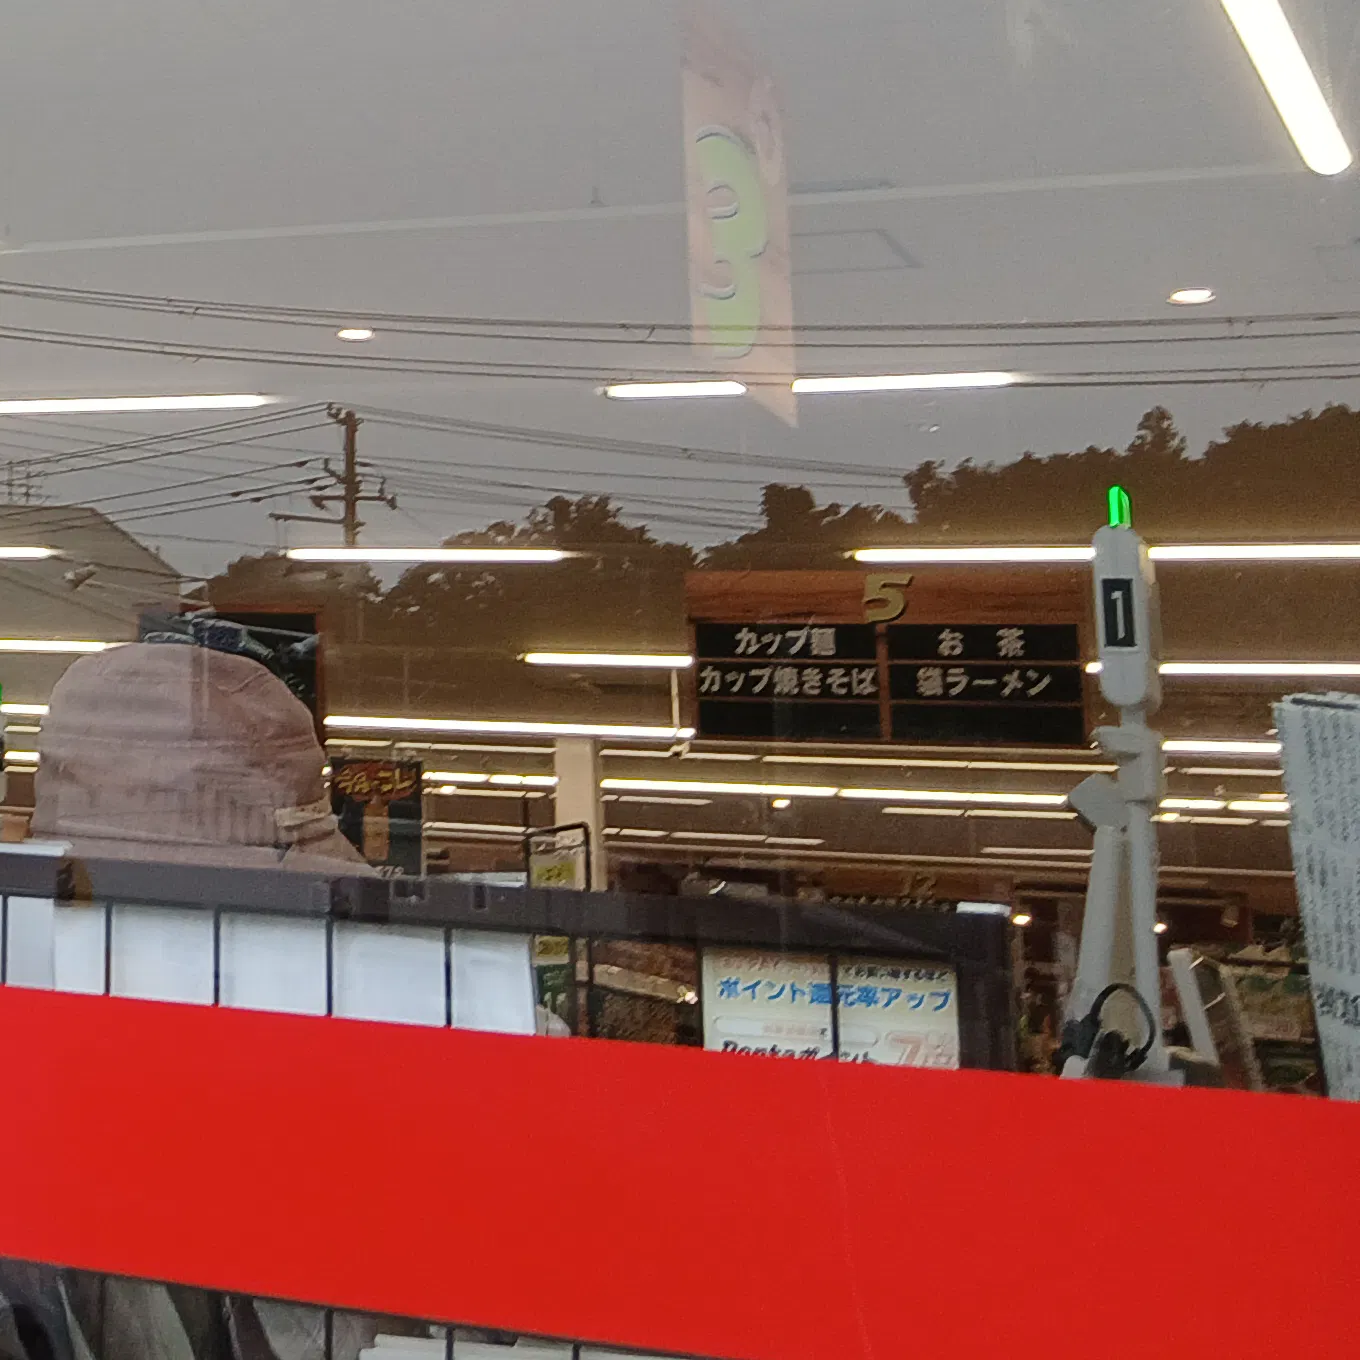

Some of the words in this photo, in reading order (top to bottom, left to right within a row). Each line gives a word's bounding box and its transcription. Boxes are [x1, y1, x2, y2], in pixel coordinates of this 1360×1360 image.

[861, 573, 914, 623] 5
[1110, 590, 1127, 640] 1
[699, 665, 879, 696] カップ焼きそば
[718, 976, 952, 1012] ポイント還元率アップ
